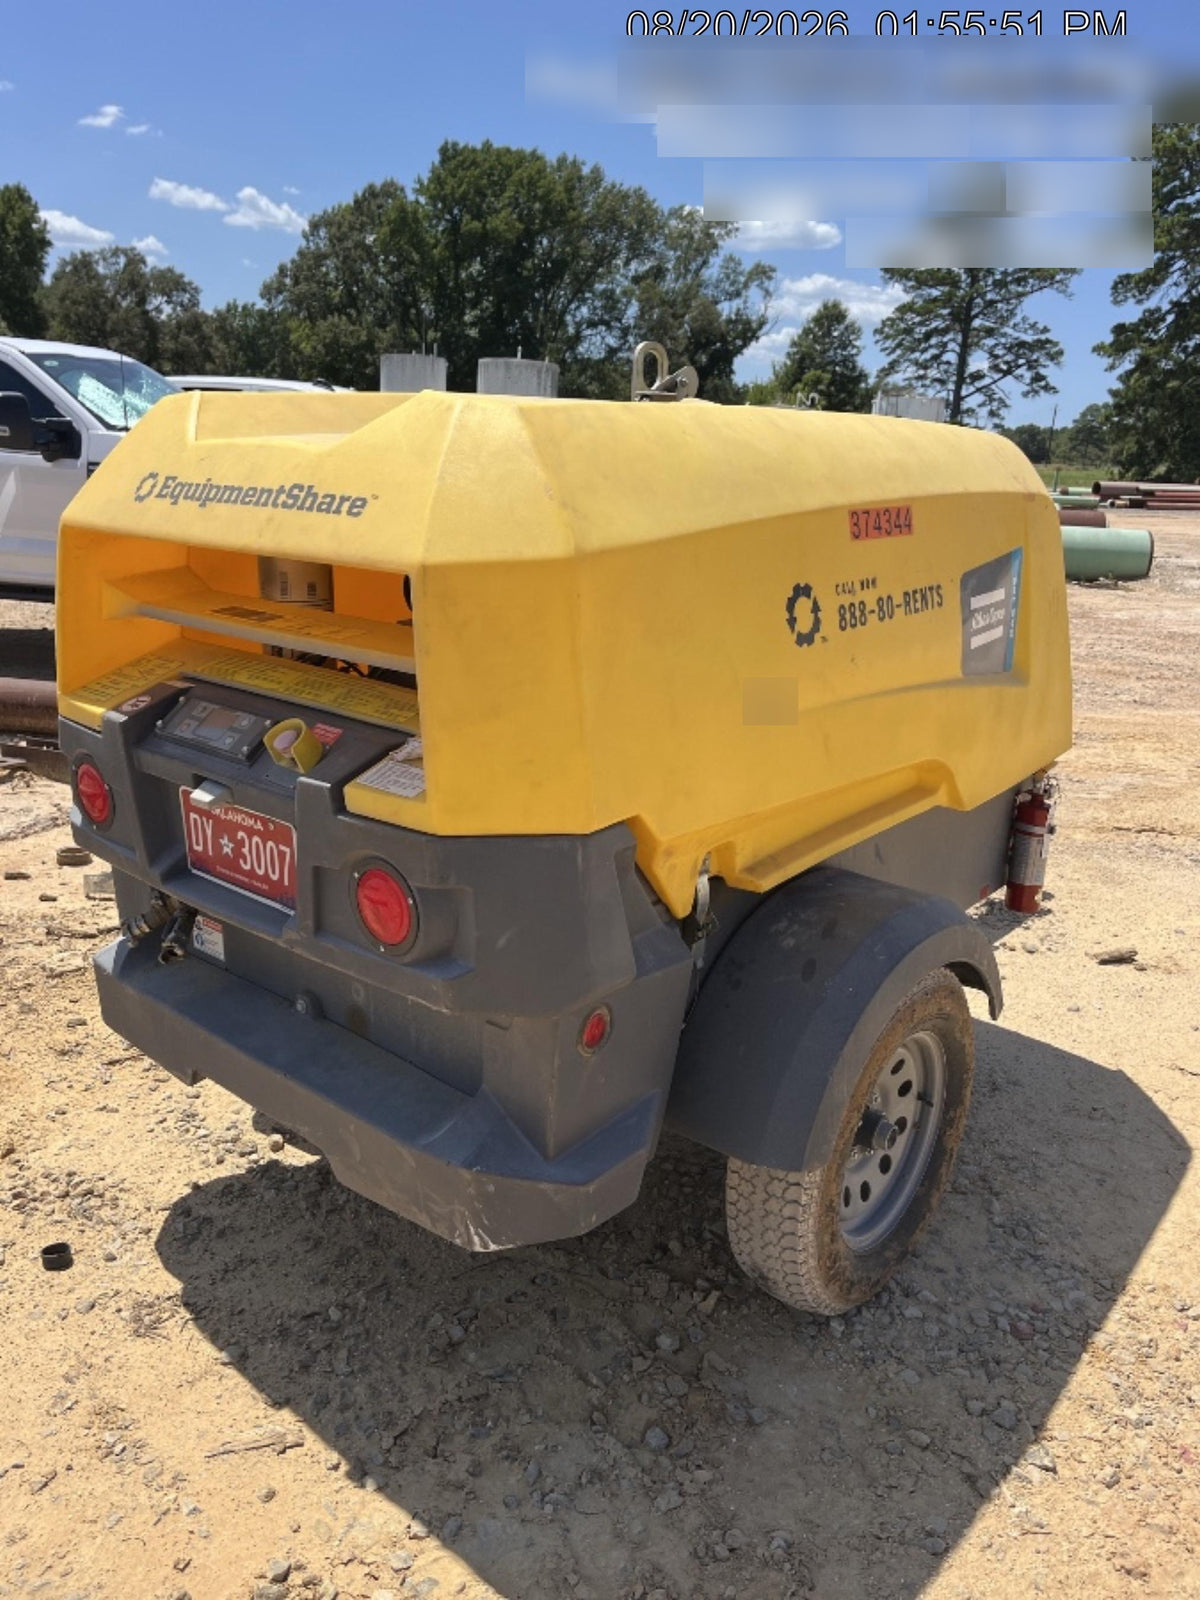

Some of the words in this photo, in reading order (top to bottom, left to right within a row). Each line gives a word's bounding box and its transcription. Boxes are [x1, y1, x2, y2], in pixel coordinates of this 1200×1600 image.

[154, 475, 368, 518] EquipmentShare
[851, 507, 911, 539] 374344
[838, 584, 943, 631] 888-80-RENTS
[190, 811, 213, 856] DY
[237, 831, 290, 886] 3007
